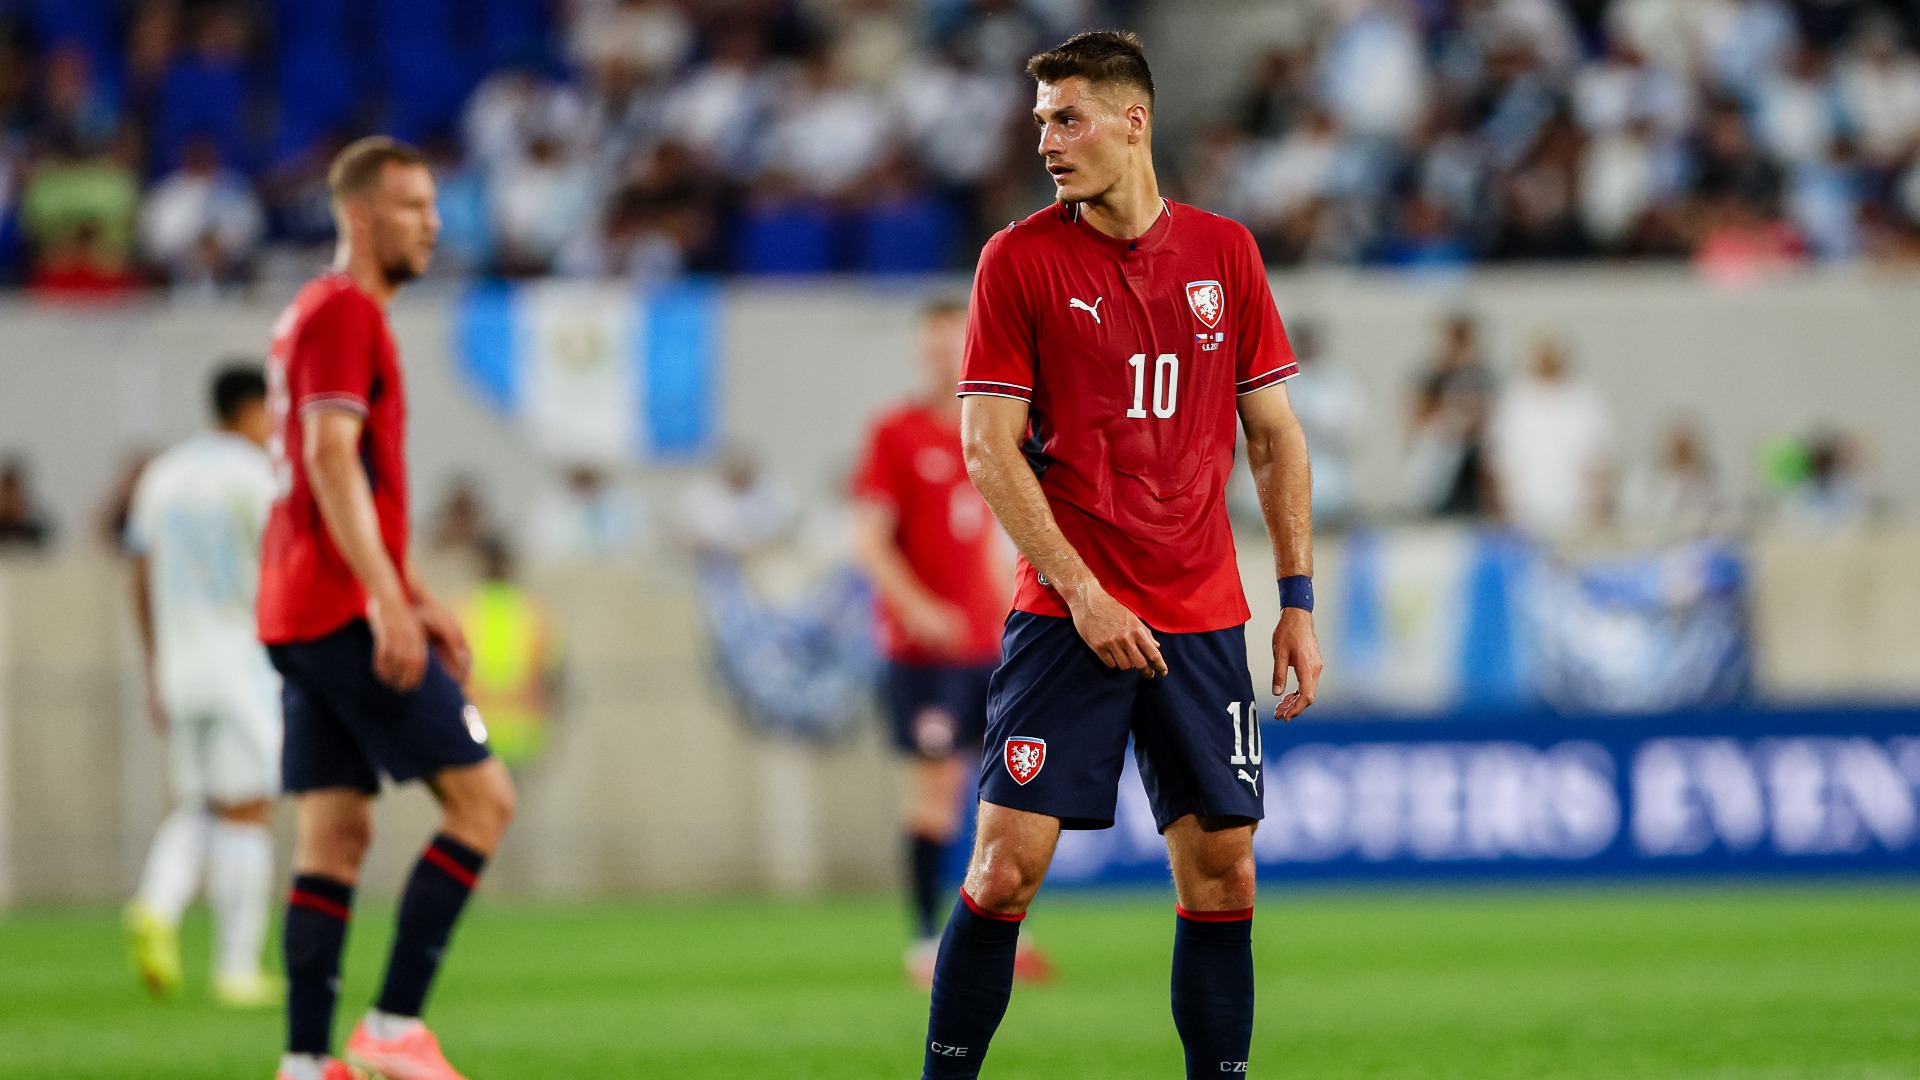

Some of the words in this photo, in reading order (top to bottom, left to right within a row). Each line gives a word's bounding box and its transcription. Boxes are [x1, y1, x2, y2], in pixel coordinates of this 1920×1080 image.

[1126, 353, 1179, 419] 10
[1226, 701, 1262, 765] 10
[1630, 736, 1920, 856] EVEN
[931, 1041, 969, 1057] CZE
